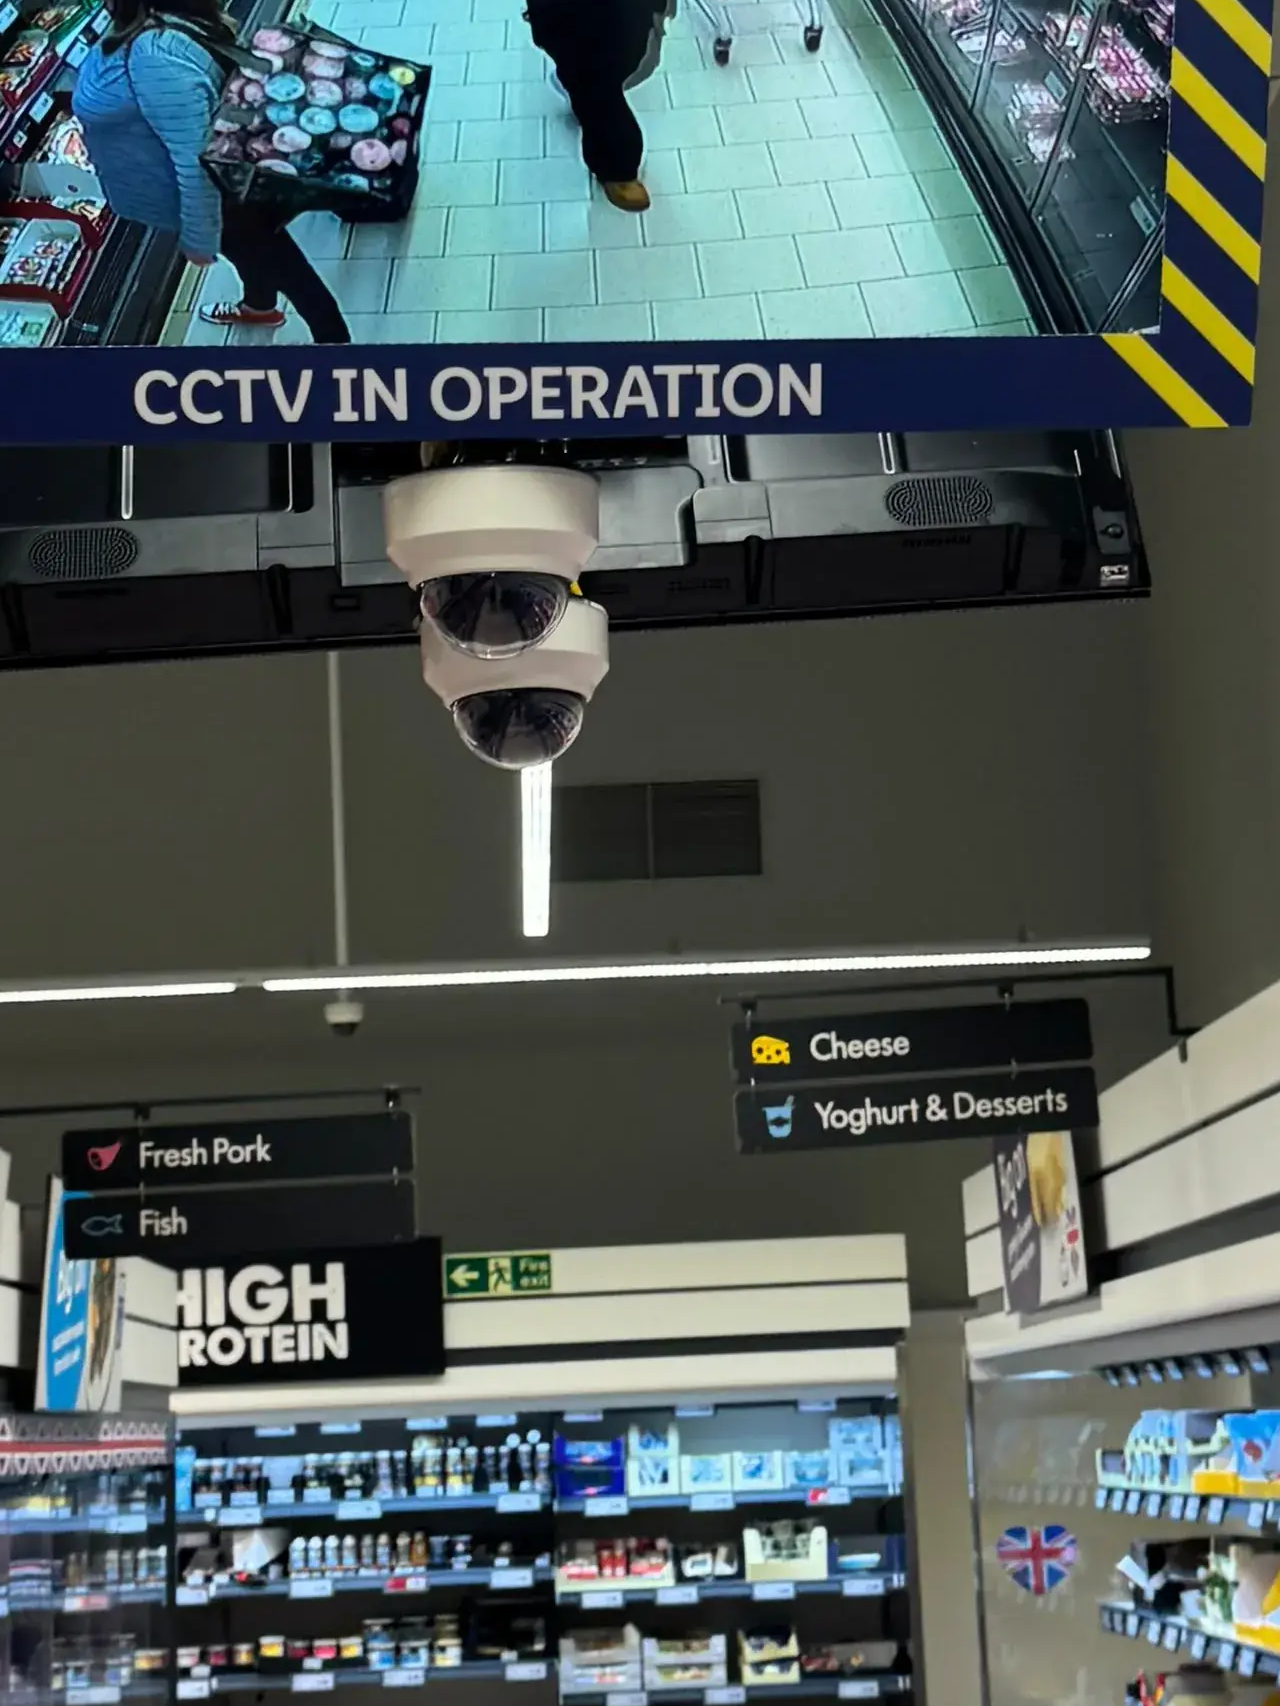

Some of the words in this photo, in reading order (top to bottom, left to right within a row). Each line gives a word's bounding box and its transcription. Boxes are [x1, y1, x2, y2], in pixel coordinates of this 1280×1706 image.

[133, 368, 314, 425] CCTV
[331, 366, 409, 423] IN
[430, 362, 824, 423] OPERATION
[809, 1030, 912, 1062] Cheese
[814, 1097, 920, 1136] Yoghurt
[925, 1093, 949, 1123] &
[953, 1088, 1069, 1120] Desserts
[138, 1137, 208, 1170] Fresh
[212, 1133, 273, 1166] Pork
[138, 1205, 188, 1237] Fish
[519, 1273, 549, 1288] exit
[177, 1321, 350, 1368] ROTEIN
